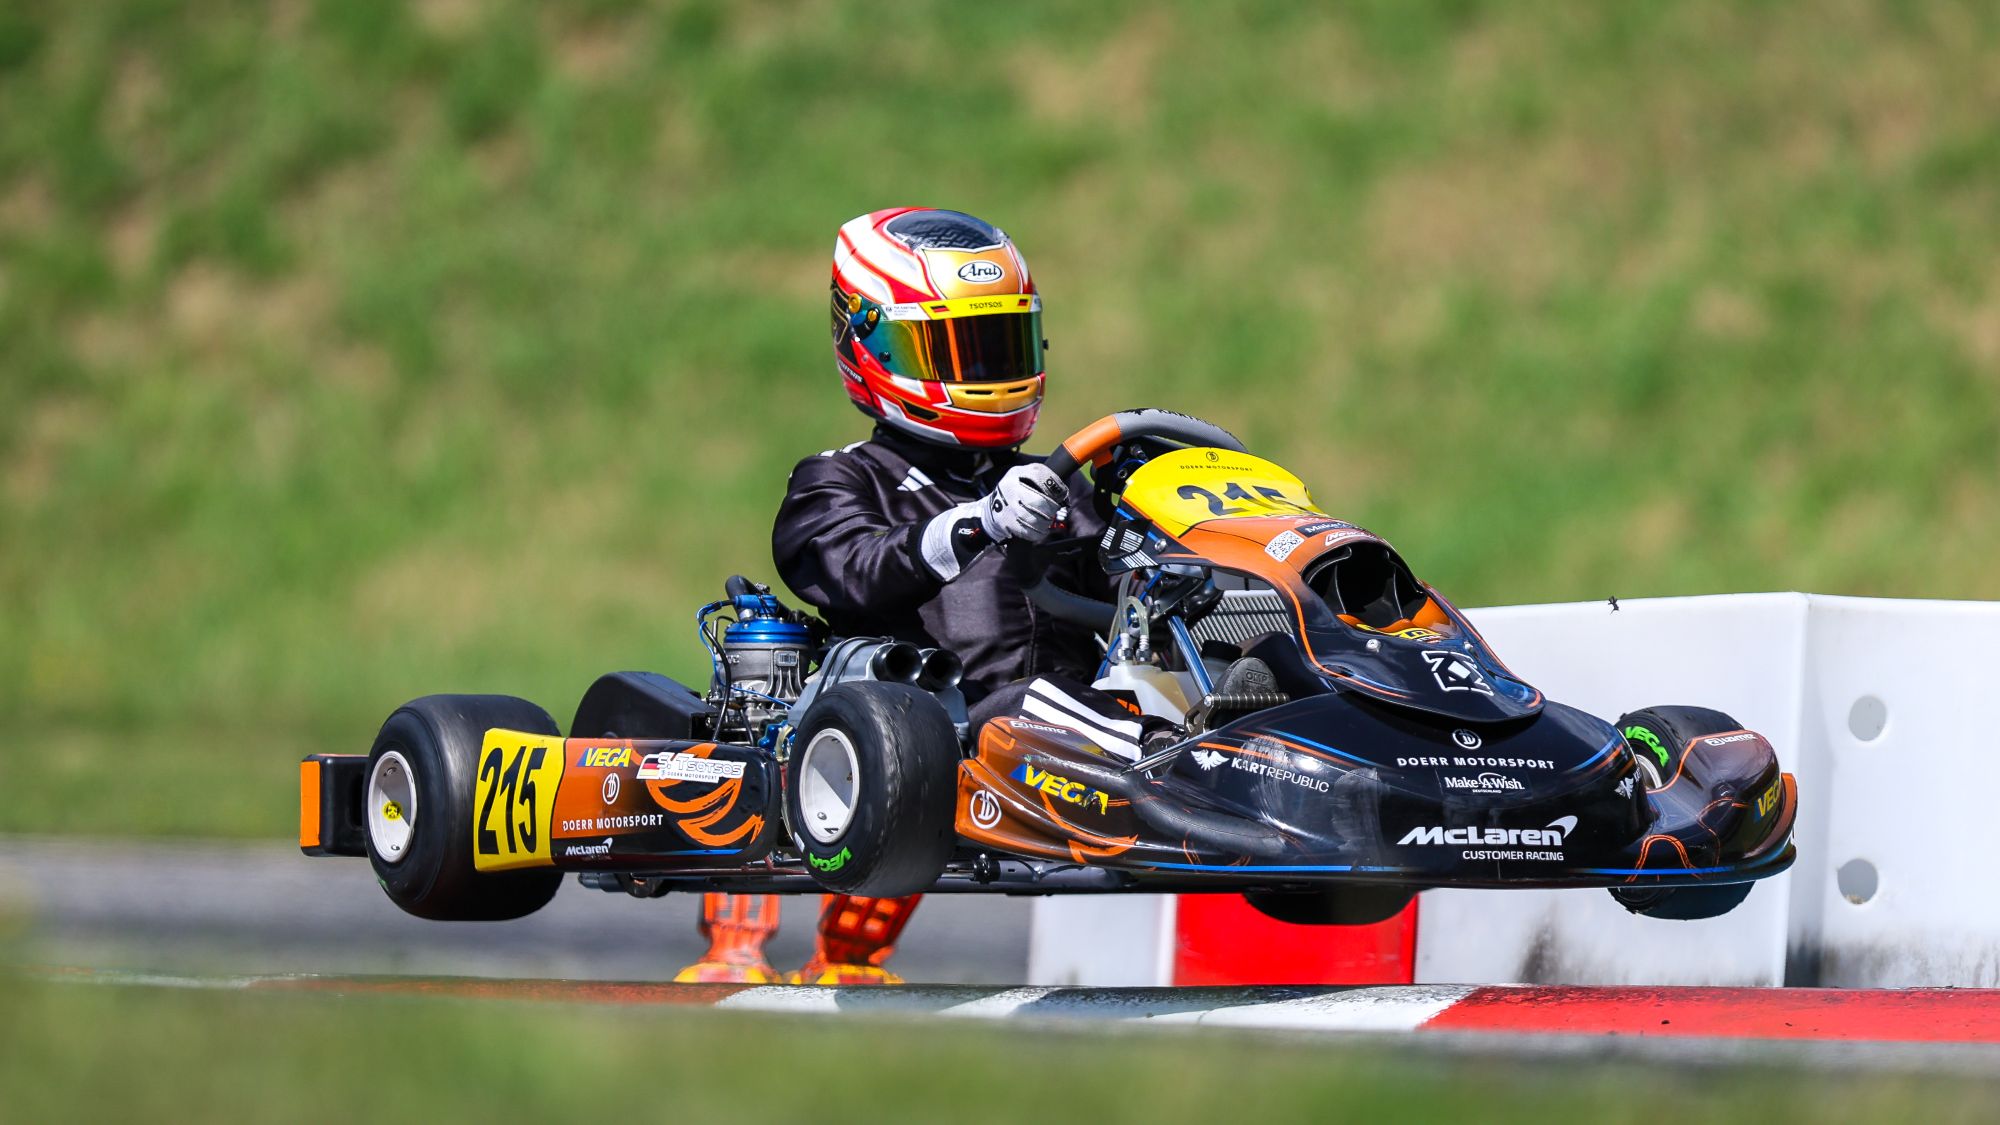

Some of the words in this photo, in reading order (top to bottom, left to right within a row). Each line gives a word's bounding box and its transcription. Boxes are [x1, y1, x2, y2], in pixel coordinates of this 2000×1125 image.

[967, 263, 998, 277] Arai
[969, 301, 1003, 310] TSOTSOS
[1245, 671, 1269, 682] OMP
[1625, 726, 1670, 768] VEGA
[584, 747, 633, 768] VEGA
[1396, 757, 1449, 767] DOERR
[1453, 757, 1555, 770] MOTORSPORT
[684, 772, 718, 780] MOTORSPORT
[1024, 764, 1109, 816] VEGA
[478, 746, 548, 856] 215
[562, 819, 593, 832] DOERR
[596, 814, 664, 830] MOTORSPORT
[1396, 825, 1563, 846] McLaren
[565, 844, 610, 856] McLaren
[1462, 850, 1524, 860] CUSTOMER
[1525, 851, 1565, 861] RACING
[809, 846, 852, 872] VEGA
